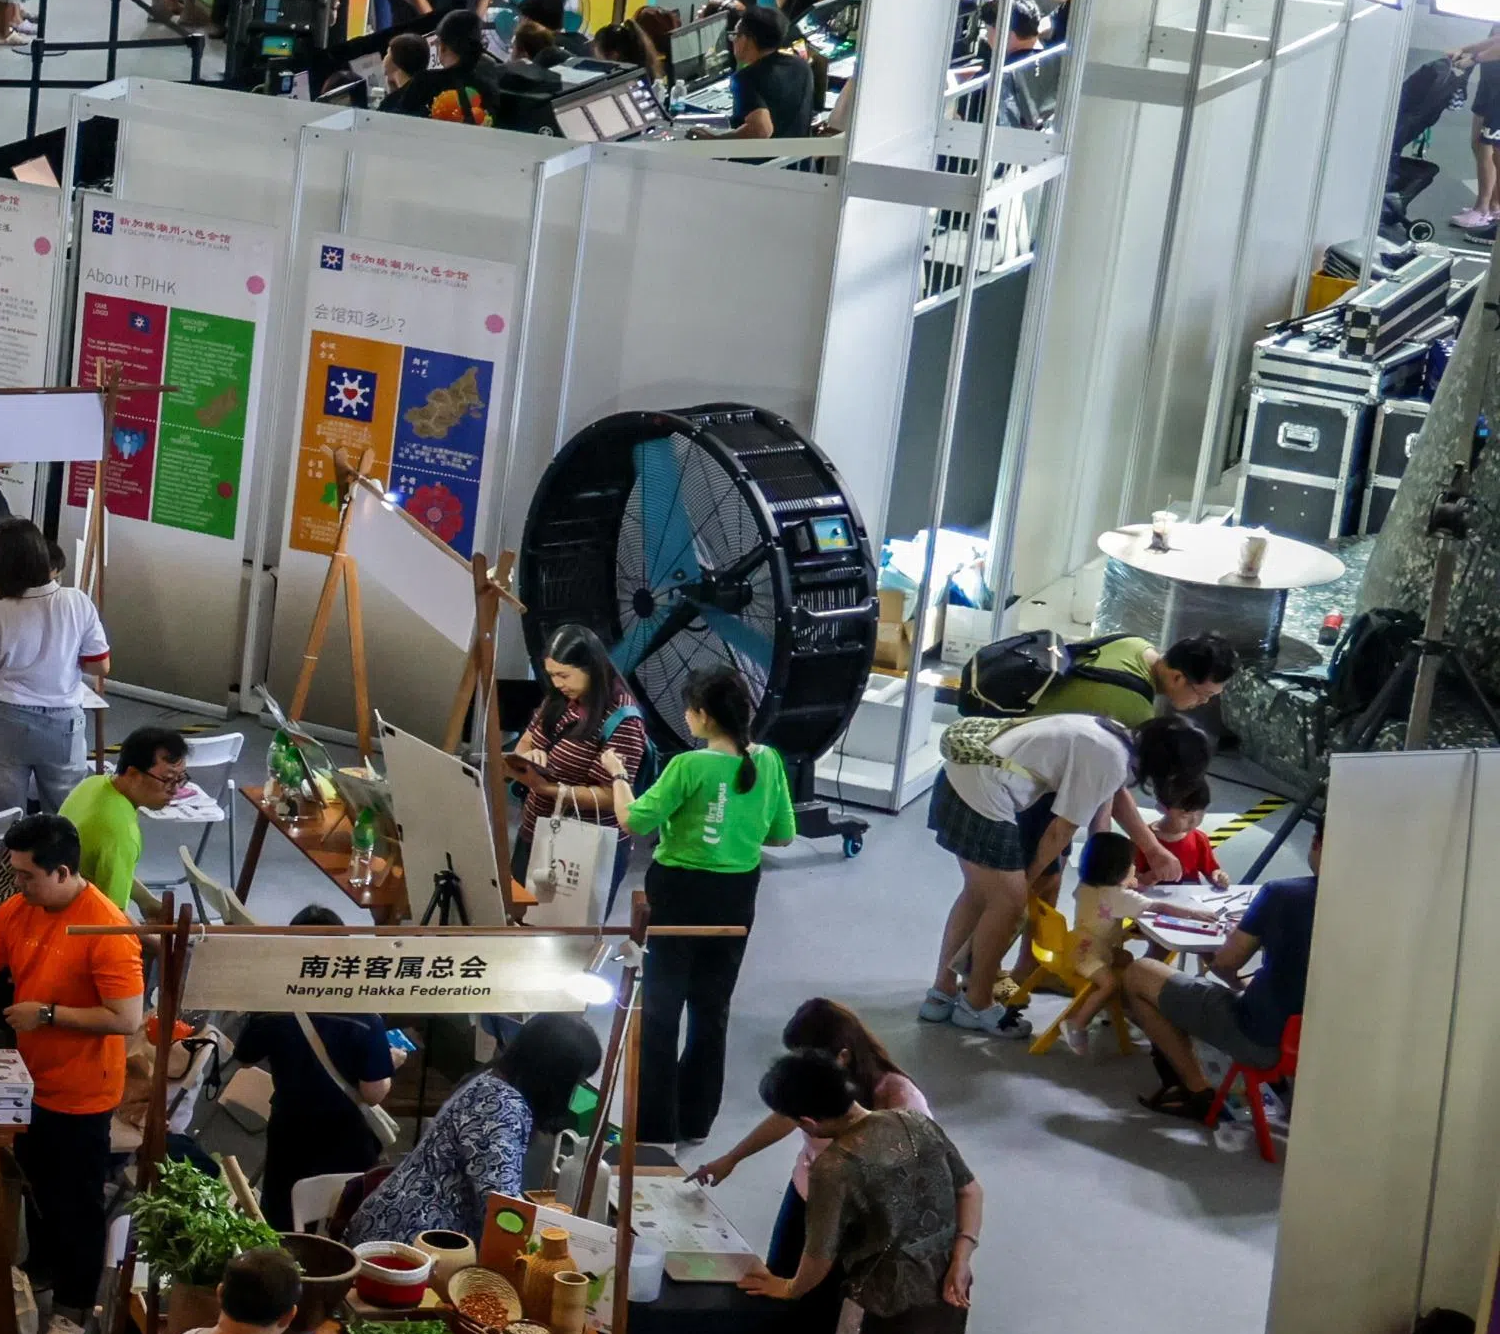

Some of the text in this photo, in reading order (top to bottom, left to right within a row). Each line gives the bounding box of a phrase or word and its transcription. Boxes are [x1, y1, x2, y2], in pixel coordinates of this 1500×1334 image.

[84, 267, 175, 296] About TPIHK
[298, 954, 489, 981] 南洋客属总会
[285, 984, 492, 1000] Nanyang Hakka Federation
